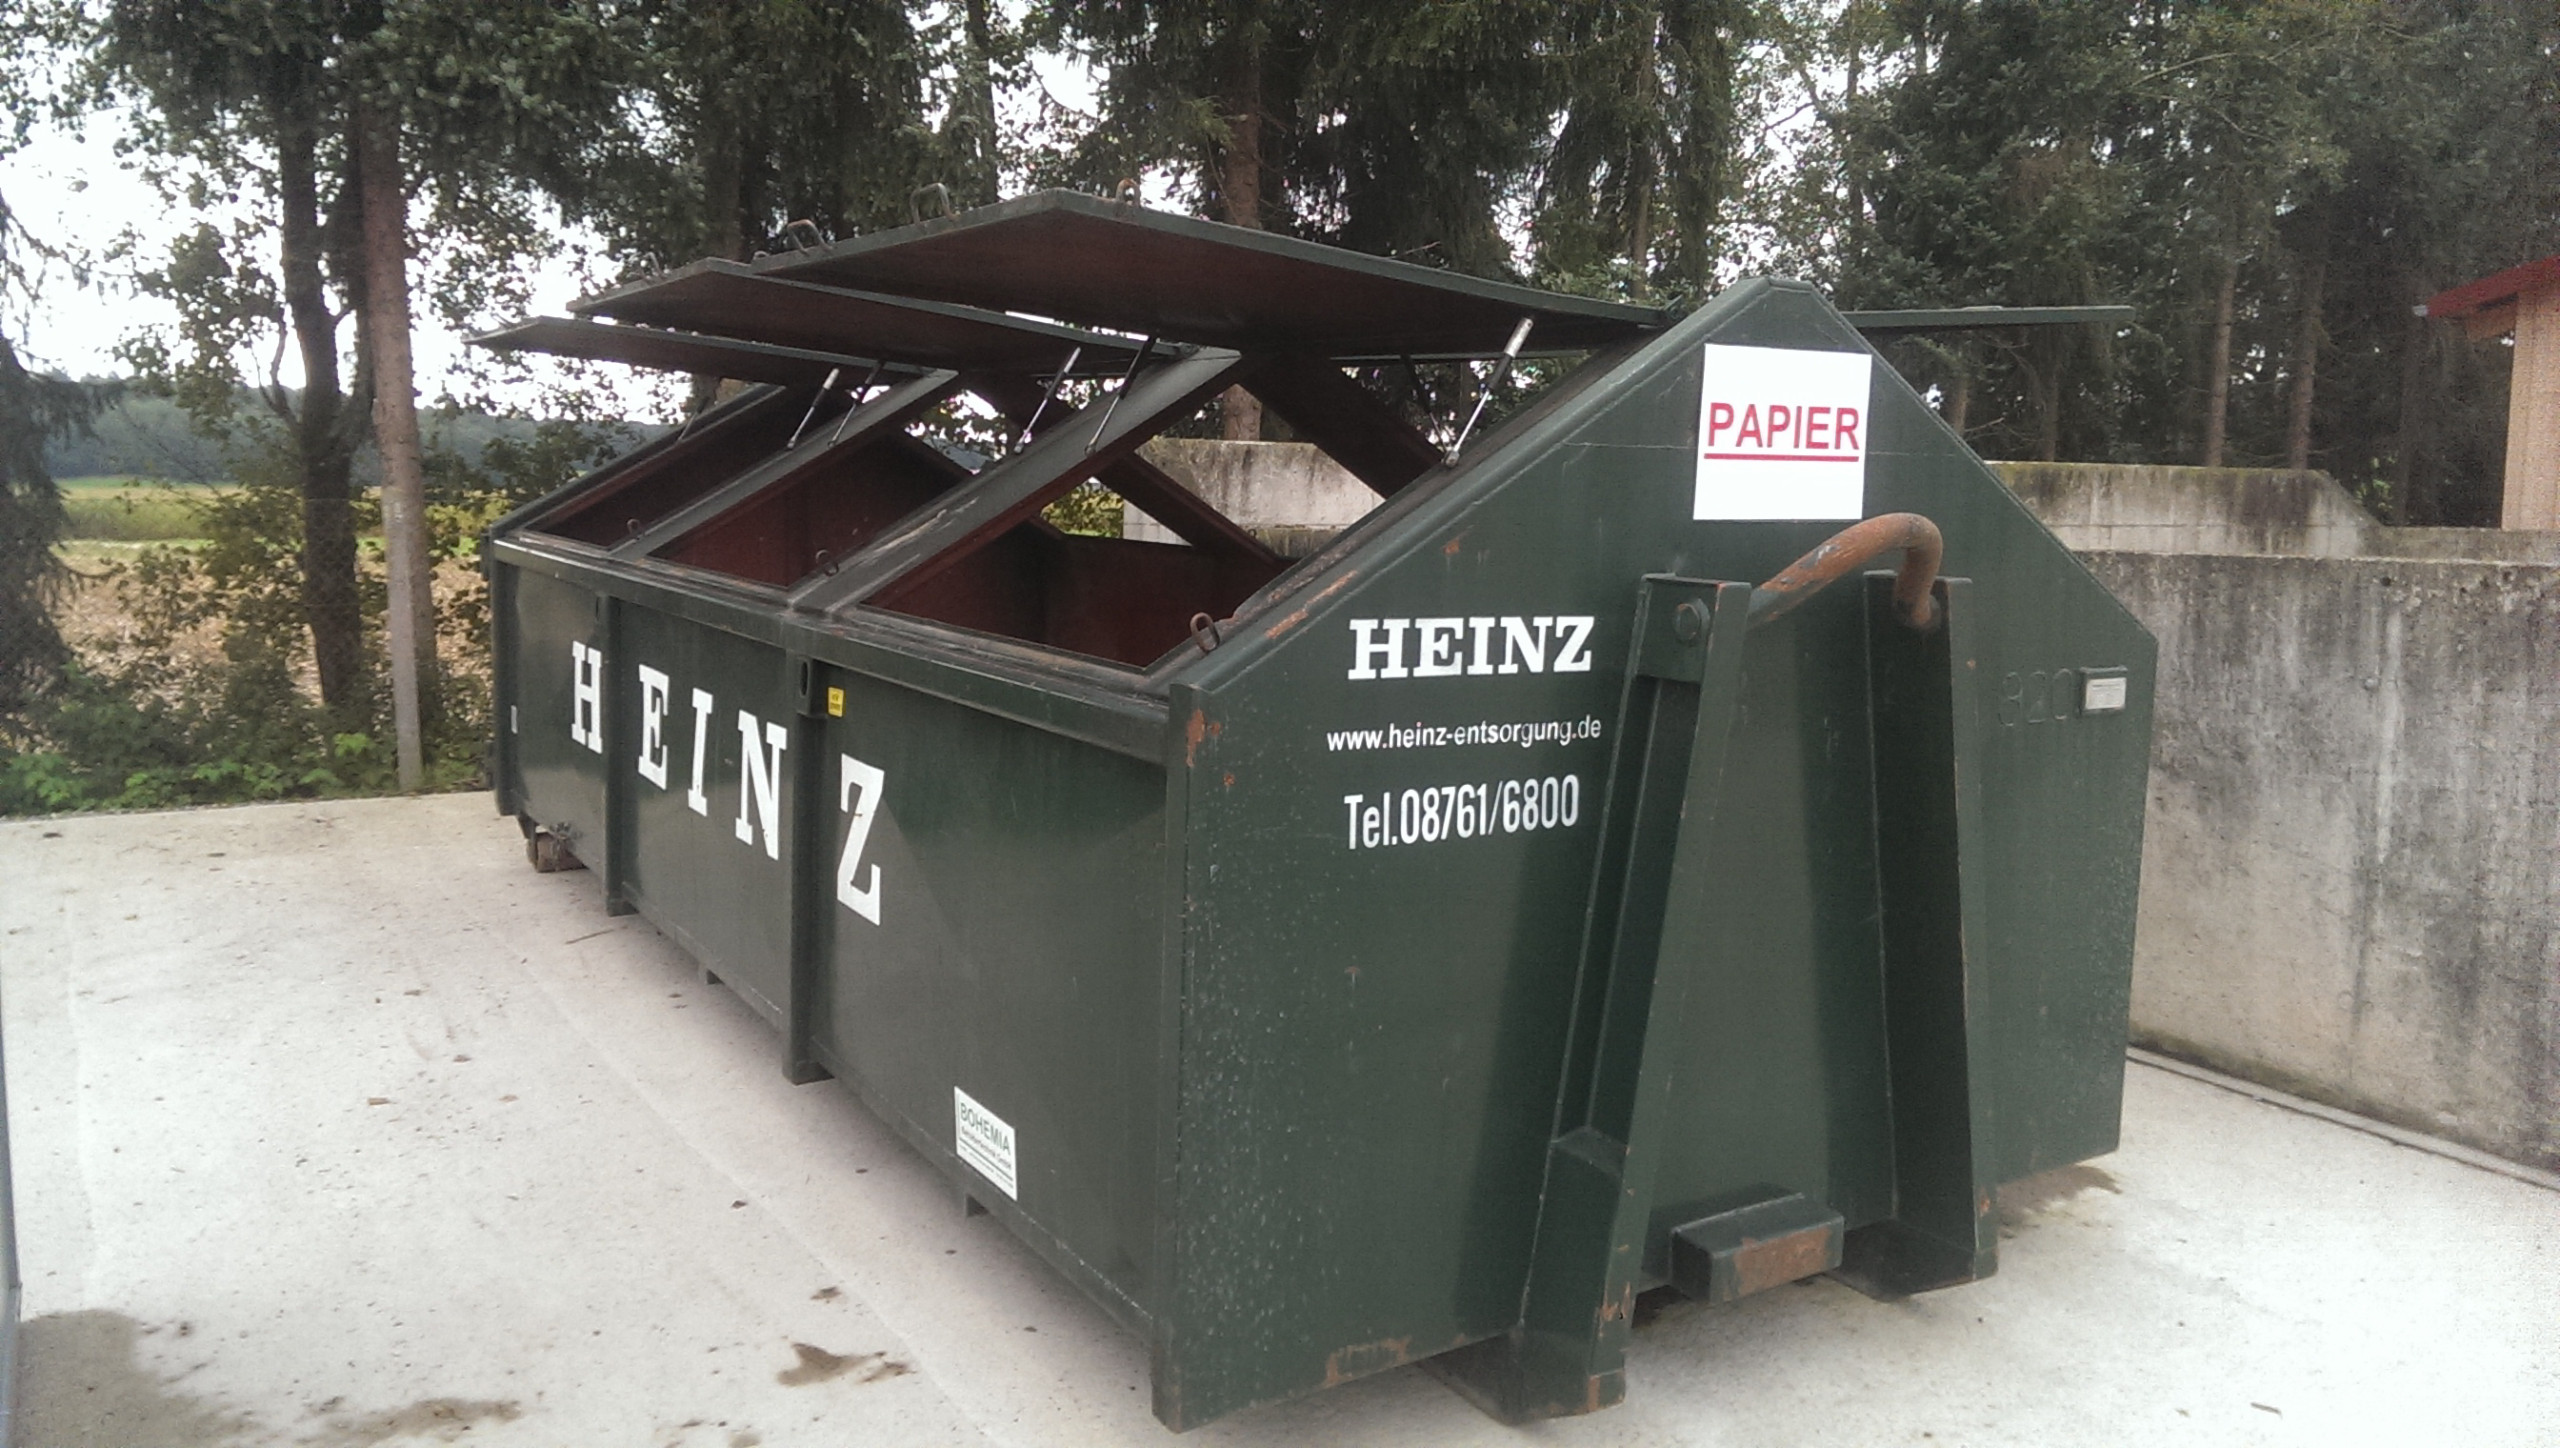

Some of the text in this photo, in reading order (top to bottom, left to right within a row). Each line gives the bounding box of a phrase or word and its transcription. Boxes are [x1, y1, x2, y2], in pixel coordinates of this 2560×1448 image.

[1709, 402, 1860, 450] PAPIER
[1348, 616, 1595, 680] HEINZ
[1326, 714, 1601, 751] www.heinz-entsorgung.de
[572, 641, 885, 925] HEINZ
[1344, 774, 1579, 850] Tel.08761/6800
[960, 1102, 1011, 1156] BOHEMIA
